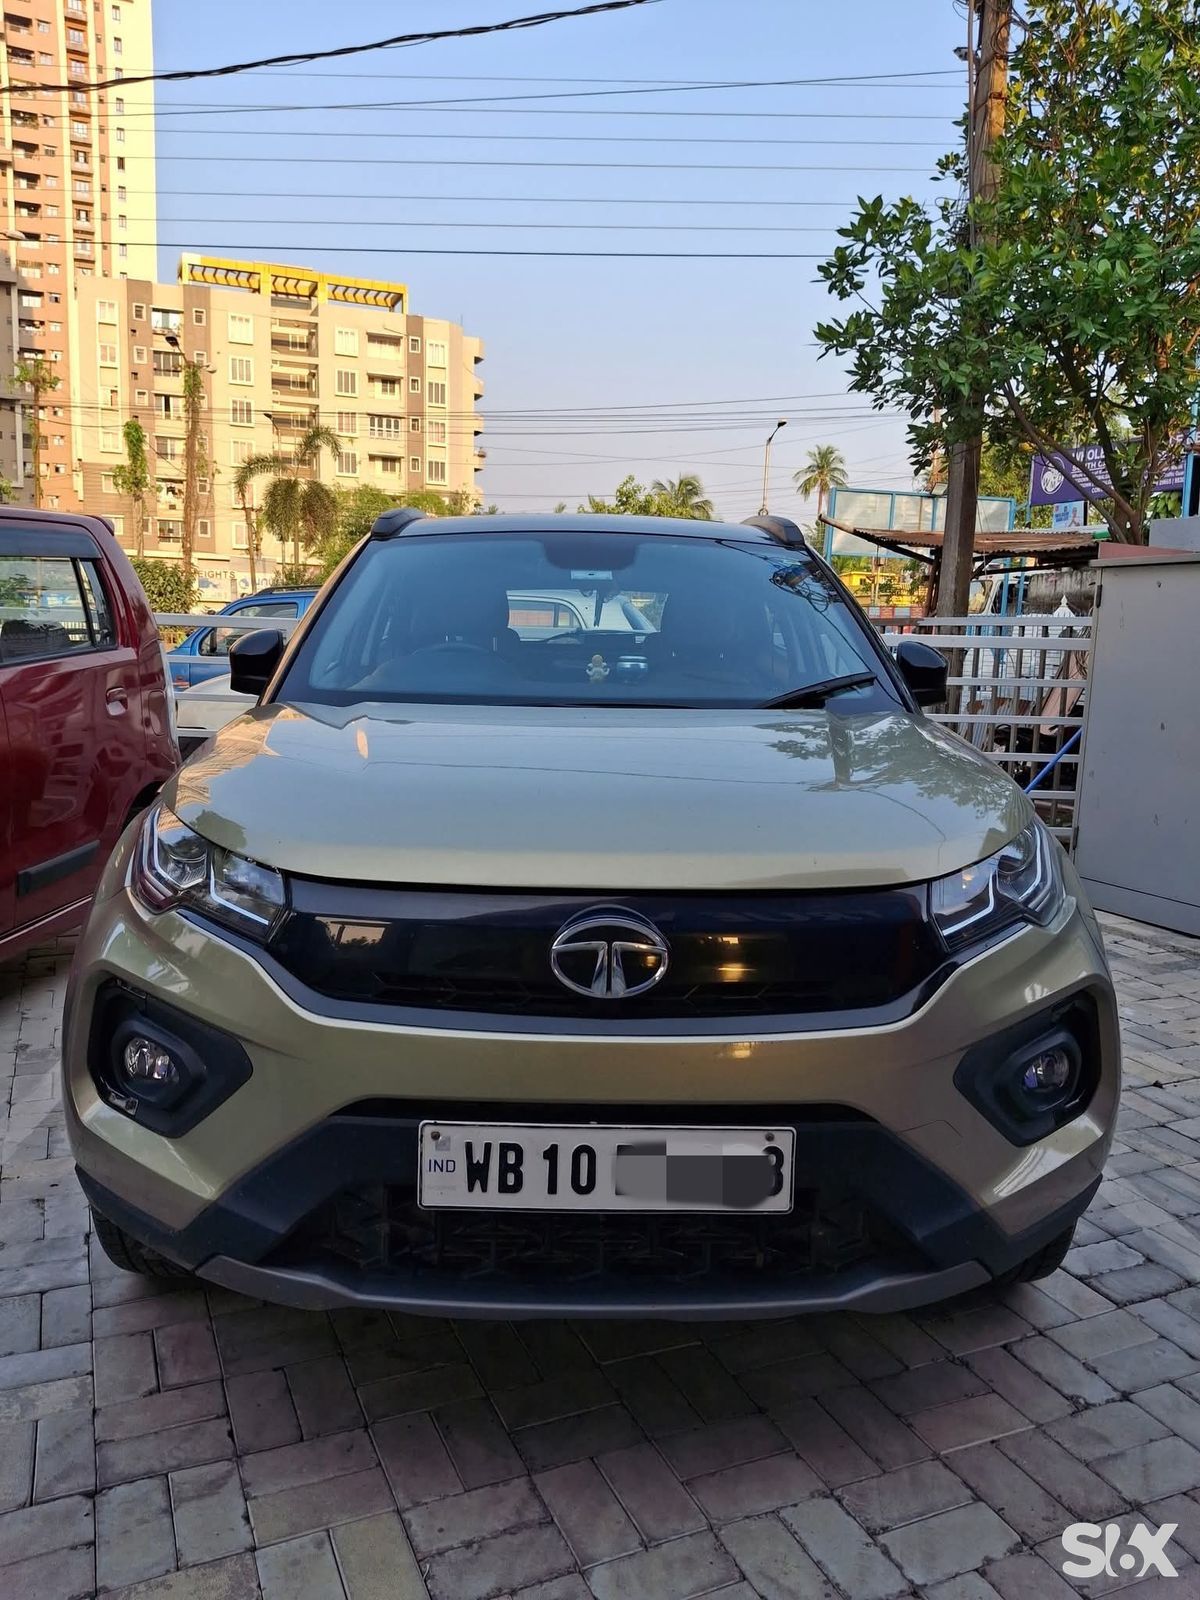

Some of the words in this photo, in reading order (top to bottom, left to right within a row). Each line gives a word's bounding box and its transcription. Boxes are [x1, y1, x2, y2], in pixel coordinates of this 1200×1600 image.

[428, 1159, 456, 1173] IND
[465, 1141, 524, 1194] WB
[543, 1144, 597, 1195] 10
